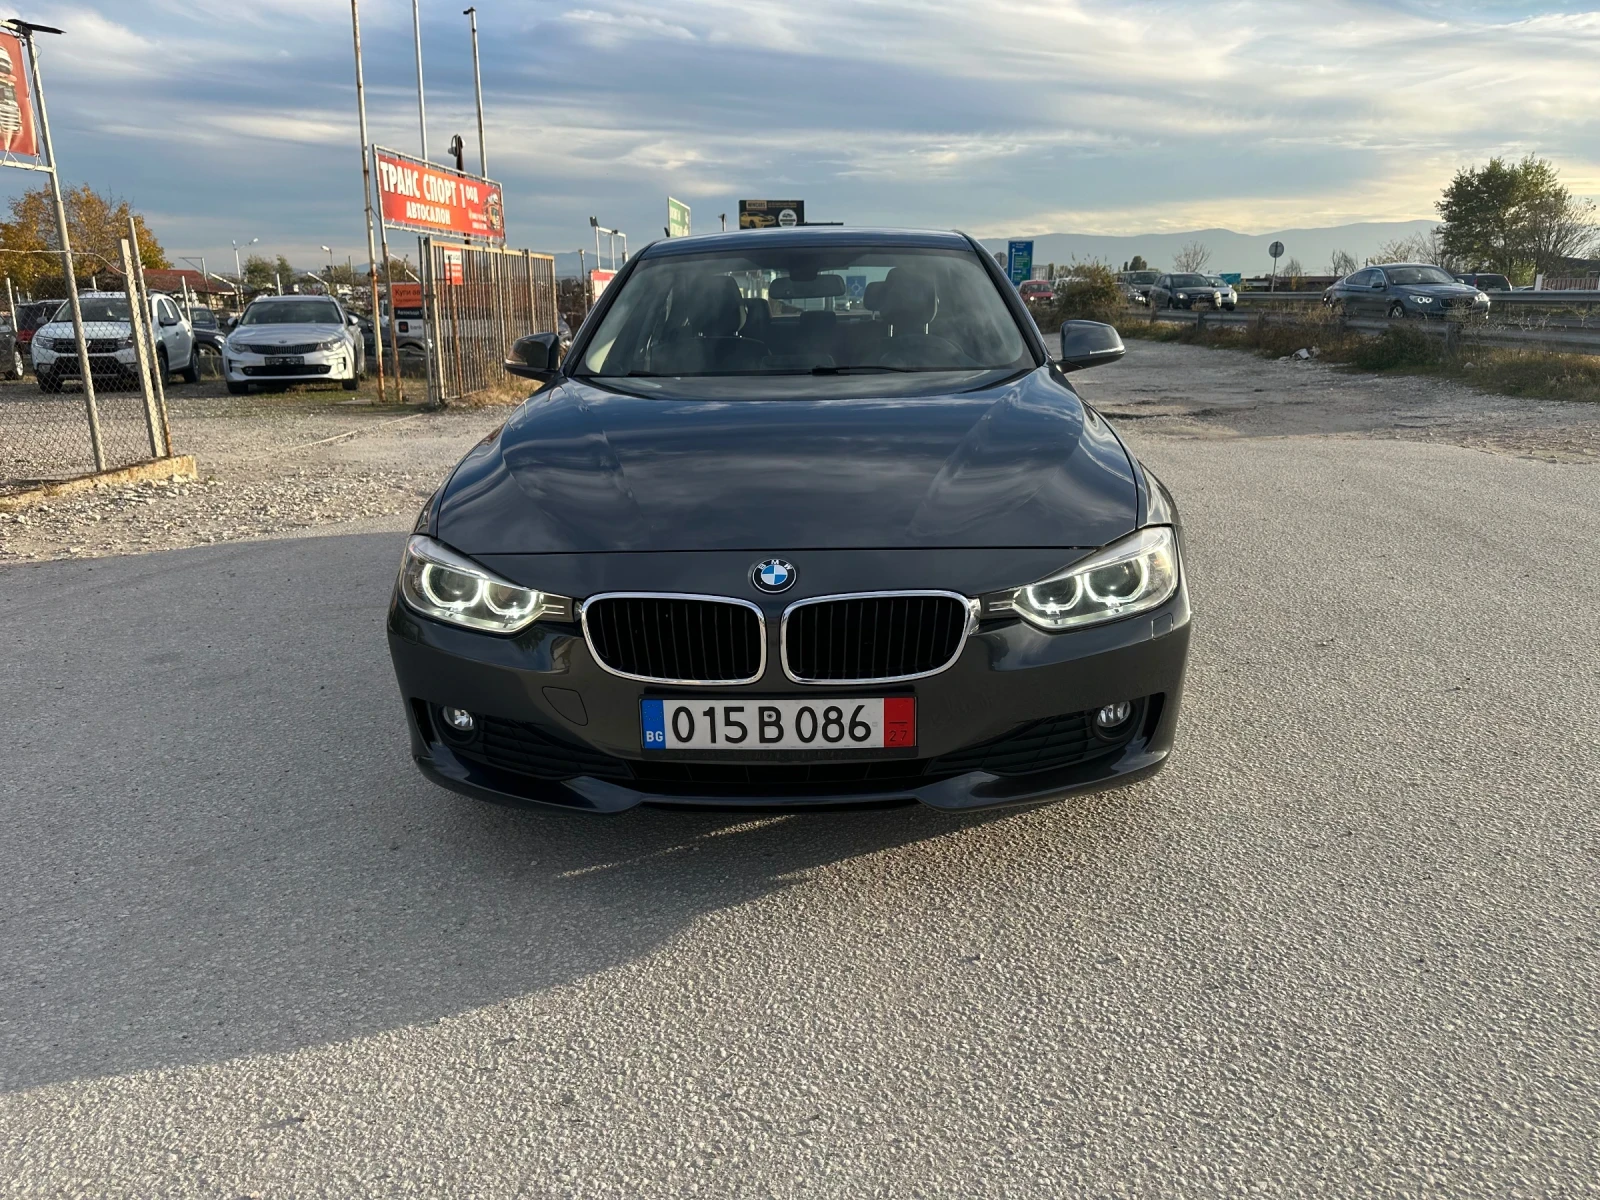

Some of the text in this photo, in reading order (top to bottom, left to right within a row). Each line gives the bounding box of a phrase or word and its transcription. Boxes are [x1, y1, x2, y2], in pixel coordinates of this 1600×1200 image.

[380, 161, 420, 199] ТРАНС
[423, 174, 456, 207] СПОРТ
[406, 201, 451, 225] АВТОСАЛОН
[757, 559, 794, 570] BMW
[646, 731, 664, 742] BG
[889, 730, 908, 742] 27
